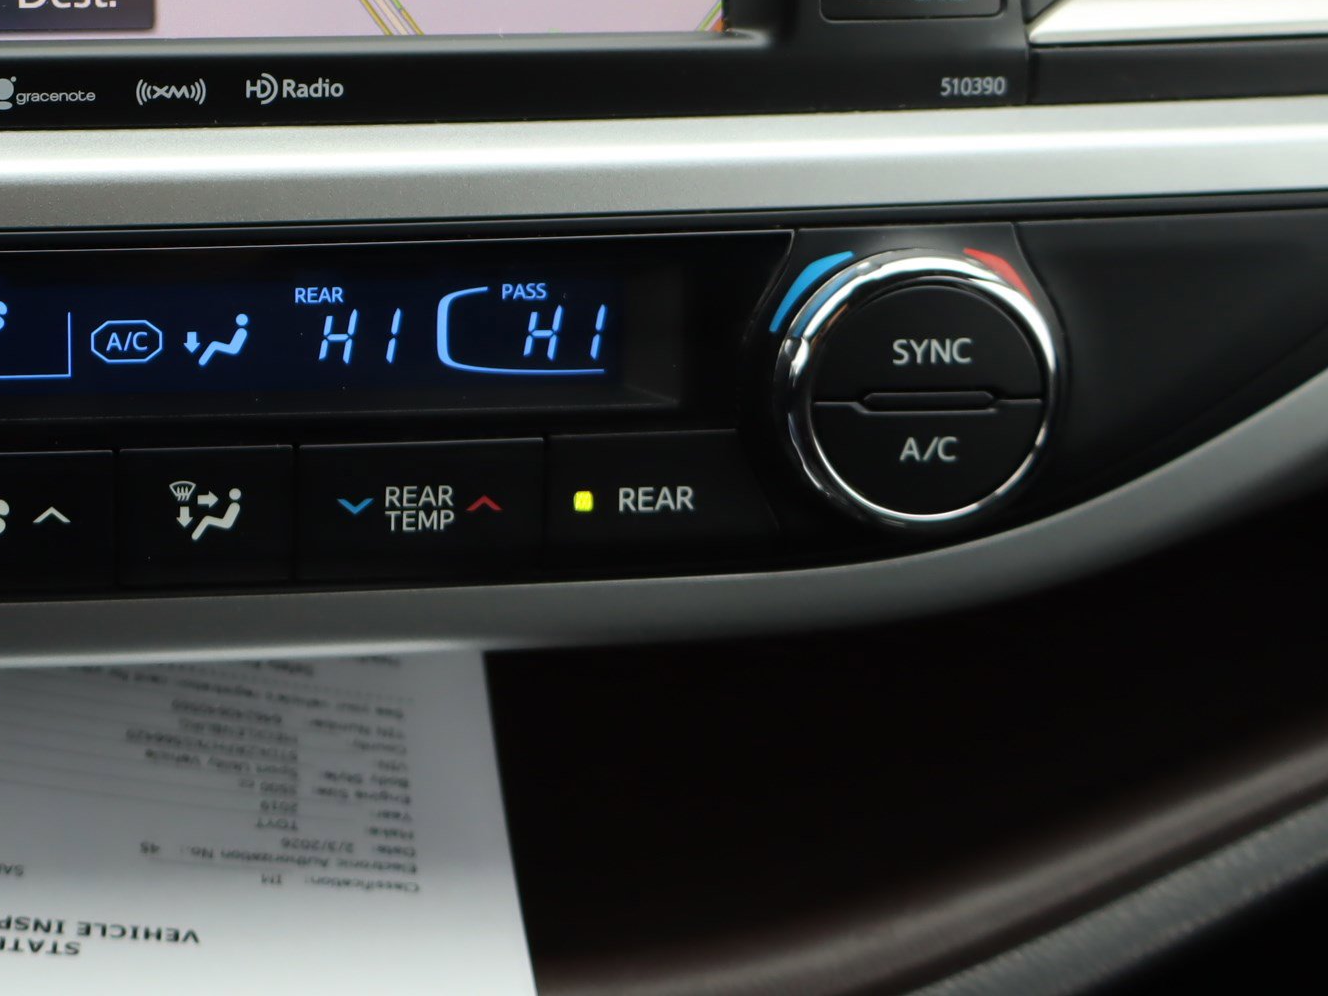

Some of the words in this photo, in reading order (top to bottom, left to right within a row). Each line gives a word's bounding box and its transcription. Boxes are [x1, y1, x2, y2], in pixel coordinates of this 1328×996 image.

[16, 89, 97, 106] gracenote
[282, 77, 345, 99] Radio
[940, 76, 1007, 97] 510390
[294, 287, 344, 304] REAR
[501, 283, 548, 301] PASS
[105, 331, 149, 352] A/C
[892, 337, 973, 365] SYNC
[899, 436, 959, 462] A/C
[385, 485, 454, 508] REAR
[617, 487, 695, 513] REAR
[385, 510, 456, 532] TEMP
[75, 920, 200, 945] VEHICLE
